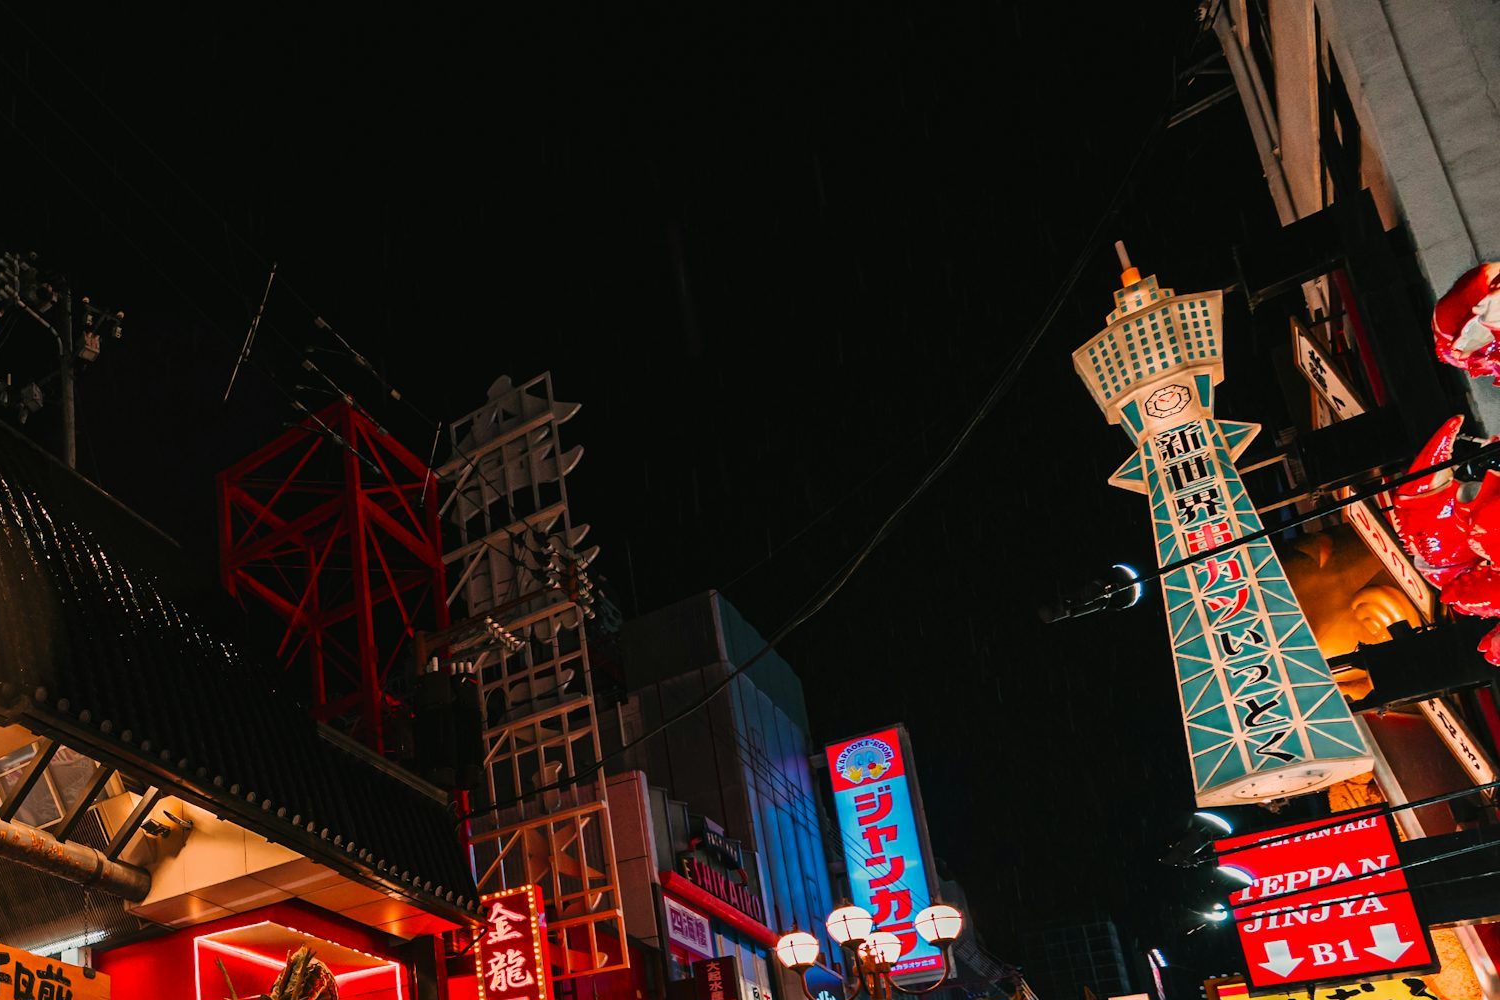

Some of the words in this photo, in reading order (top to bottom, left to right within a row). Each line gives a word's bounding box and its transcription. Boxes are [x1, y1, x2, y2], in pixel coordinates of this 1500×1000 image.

[853, 784, 917, 957] ジャンカラ
[1237, 854, 1390, 902] TEPPAN
[1243, 892, 1388, 933] JINJYA
[1308, 939, 1359, 967] B1
[706, 961, 725, 1000] 大起水産
